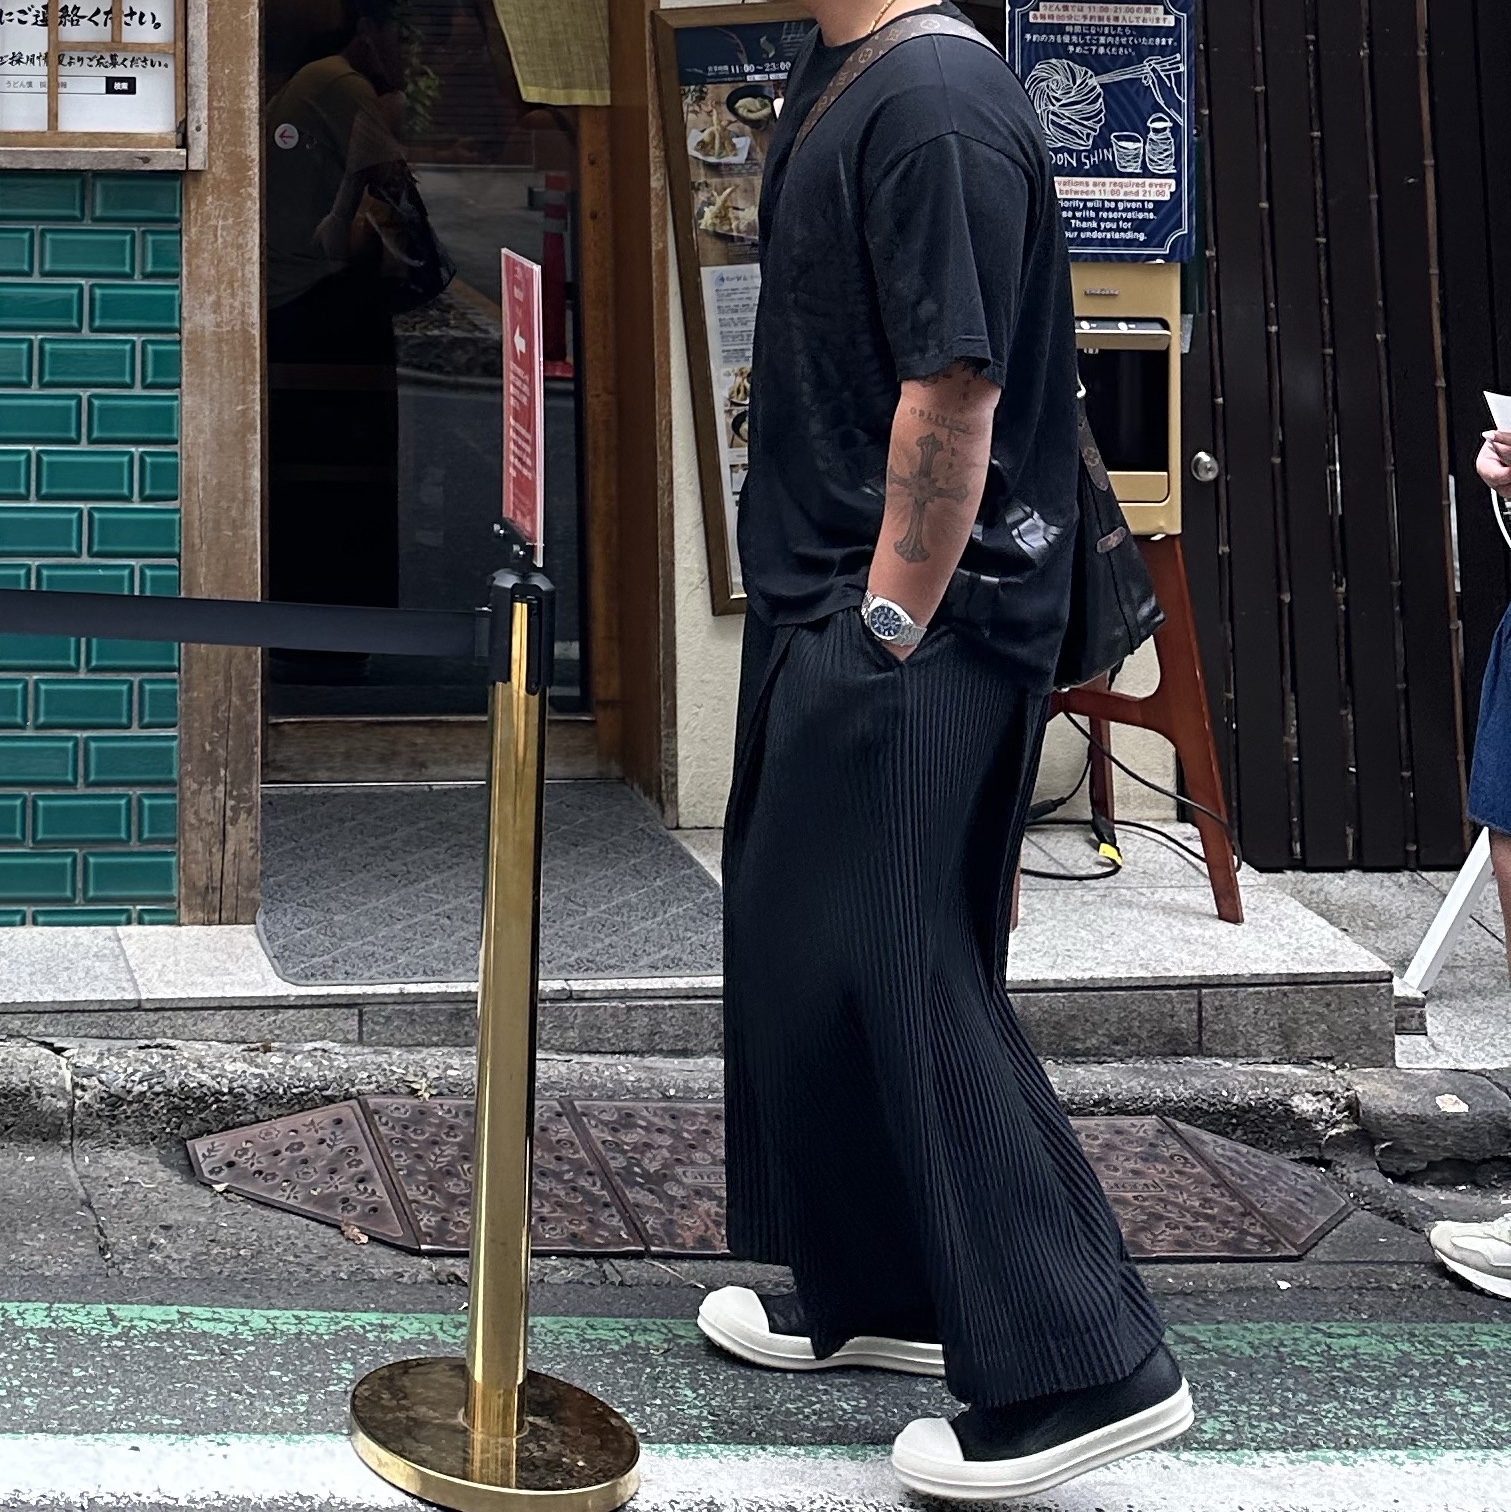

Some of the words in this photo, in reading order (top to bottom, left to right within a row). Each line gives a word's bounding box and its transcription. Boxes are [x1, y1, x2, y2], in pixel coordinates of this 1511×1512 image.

[113, 81, 129, 91] 検索
[1048, 151, 1077, 168] DON
[1081, 147, 1113, 169] SHIN
[1109, 180, 1146, 189] required
[1148, 182, 1173, 190] every
[1059, 188, 1096, 196] between
[1123, 189, 1139, 197] and
[1058, 200, 1085, 209] iority
[1086, 200, 1103, 208] will
[1118, 201, 1143, 210] given
[1144, 201, 1154, 209] to
[1075, 210, 1096, 218] with
[1099, 210, 1157, 220] reservations.
[1070, 220, 1098, 228] Thank
[1100, 221, 1117, 230] you
[1119, 220, 1132, 228] for
[1080, 231, 1147, 241] understanding.
